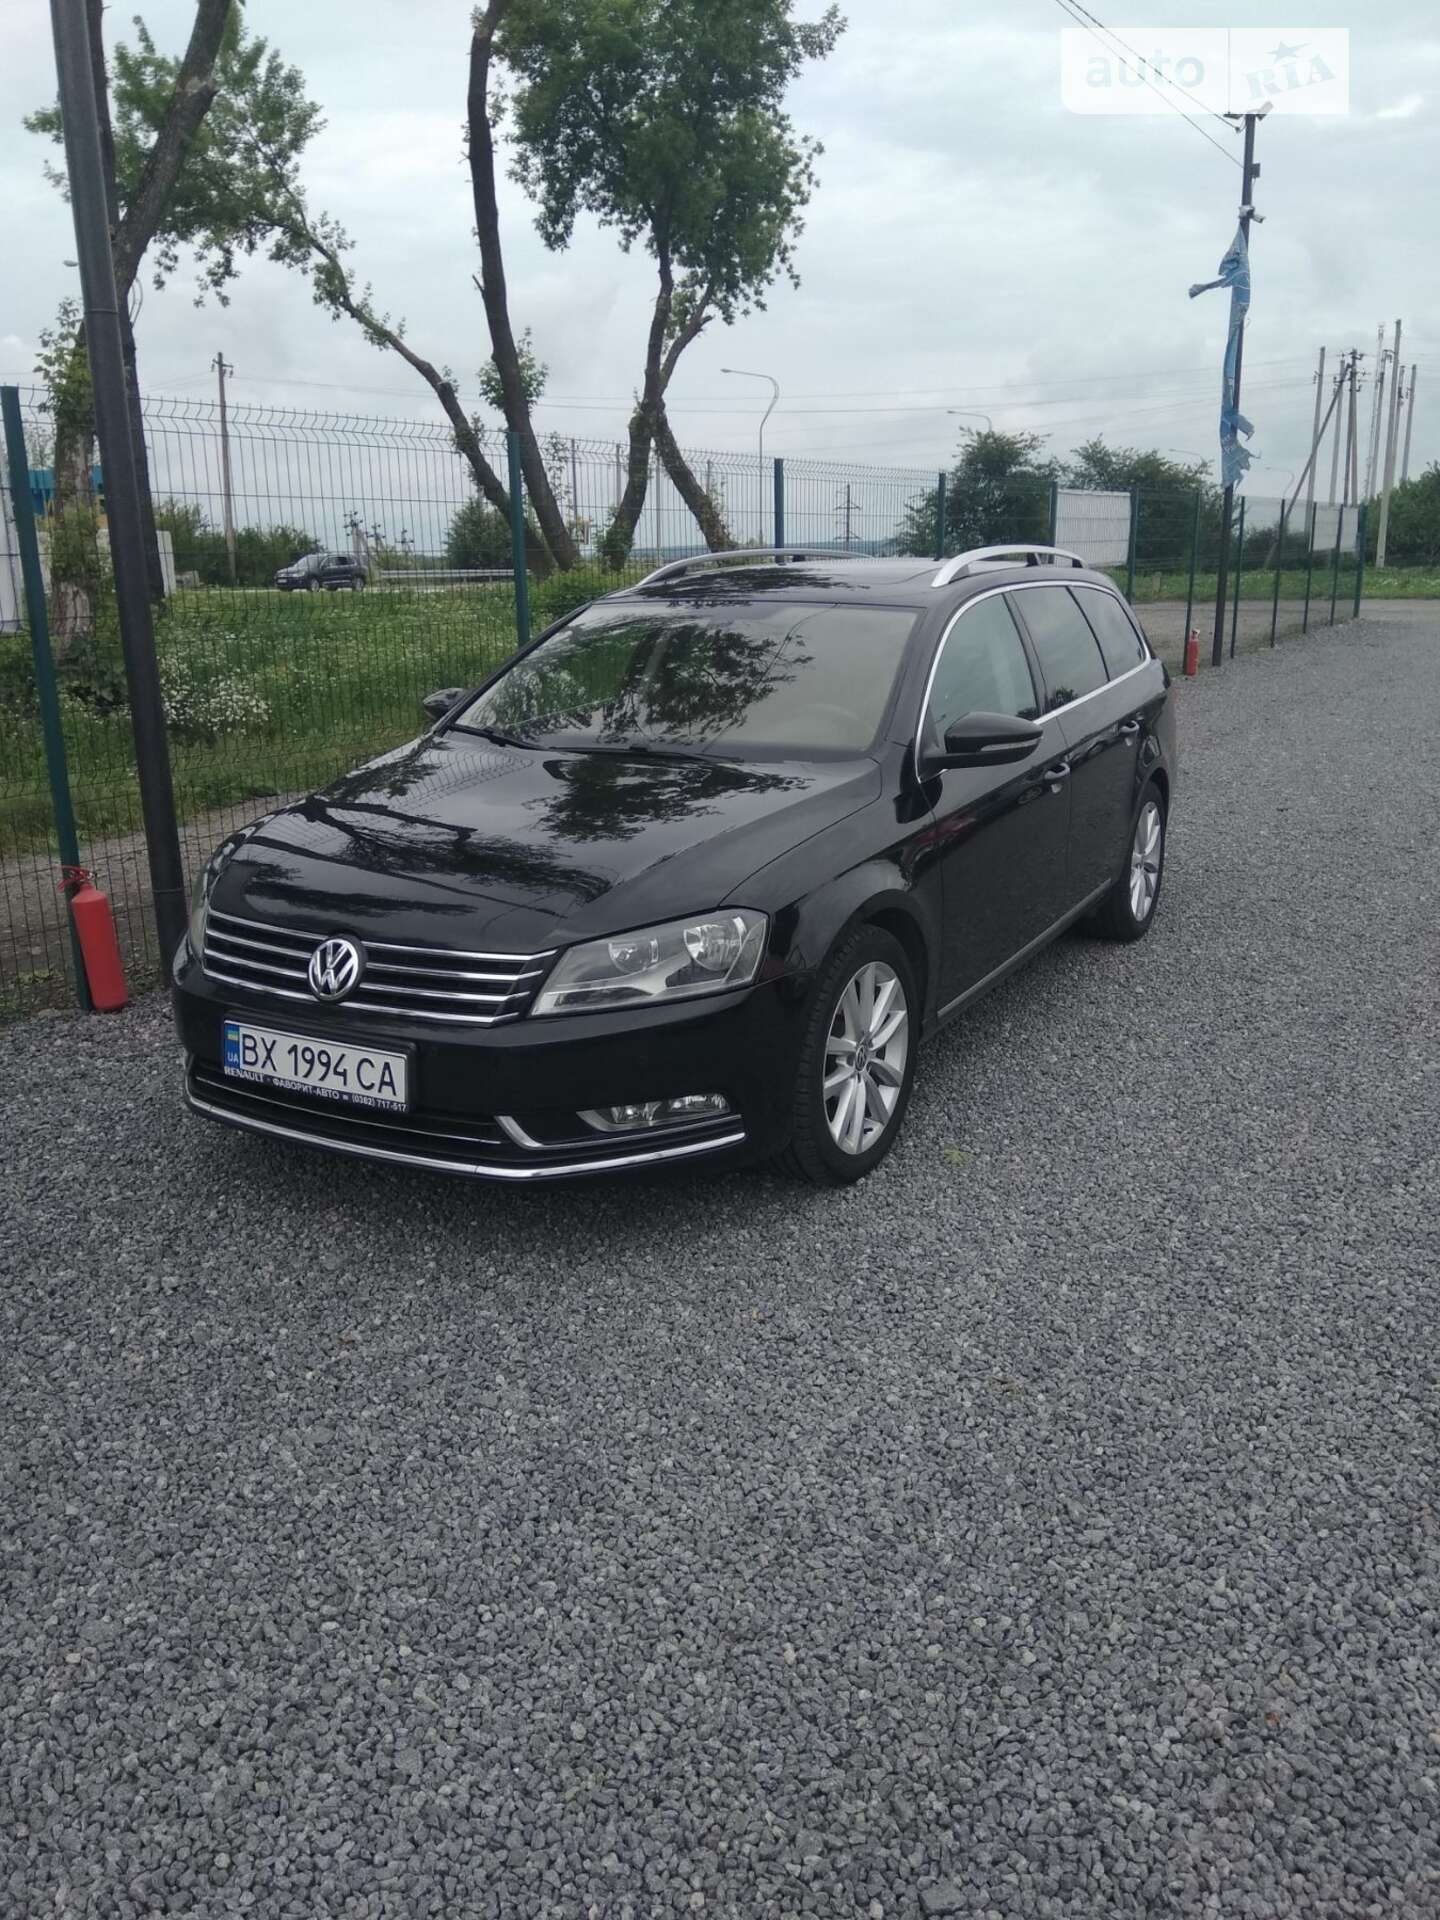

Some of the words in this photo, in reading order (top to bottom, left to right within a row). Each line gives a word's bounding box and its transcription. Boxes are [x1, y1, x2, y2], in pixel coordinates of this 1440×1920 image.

[227, 1052, 239, 1063] UA
[242, 1033, 277, 1072] BX
[287, 1044, 347, 1087] 1994
[356, 1057, 397, 1096] CA
[224, 1067, 264, 1083] RENAULT
[273, 1079, 340, 1099] ФАВОРИТ-АВТО
